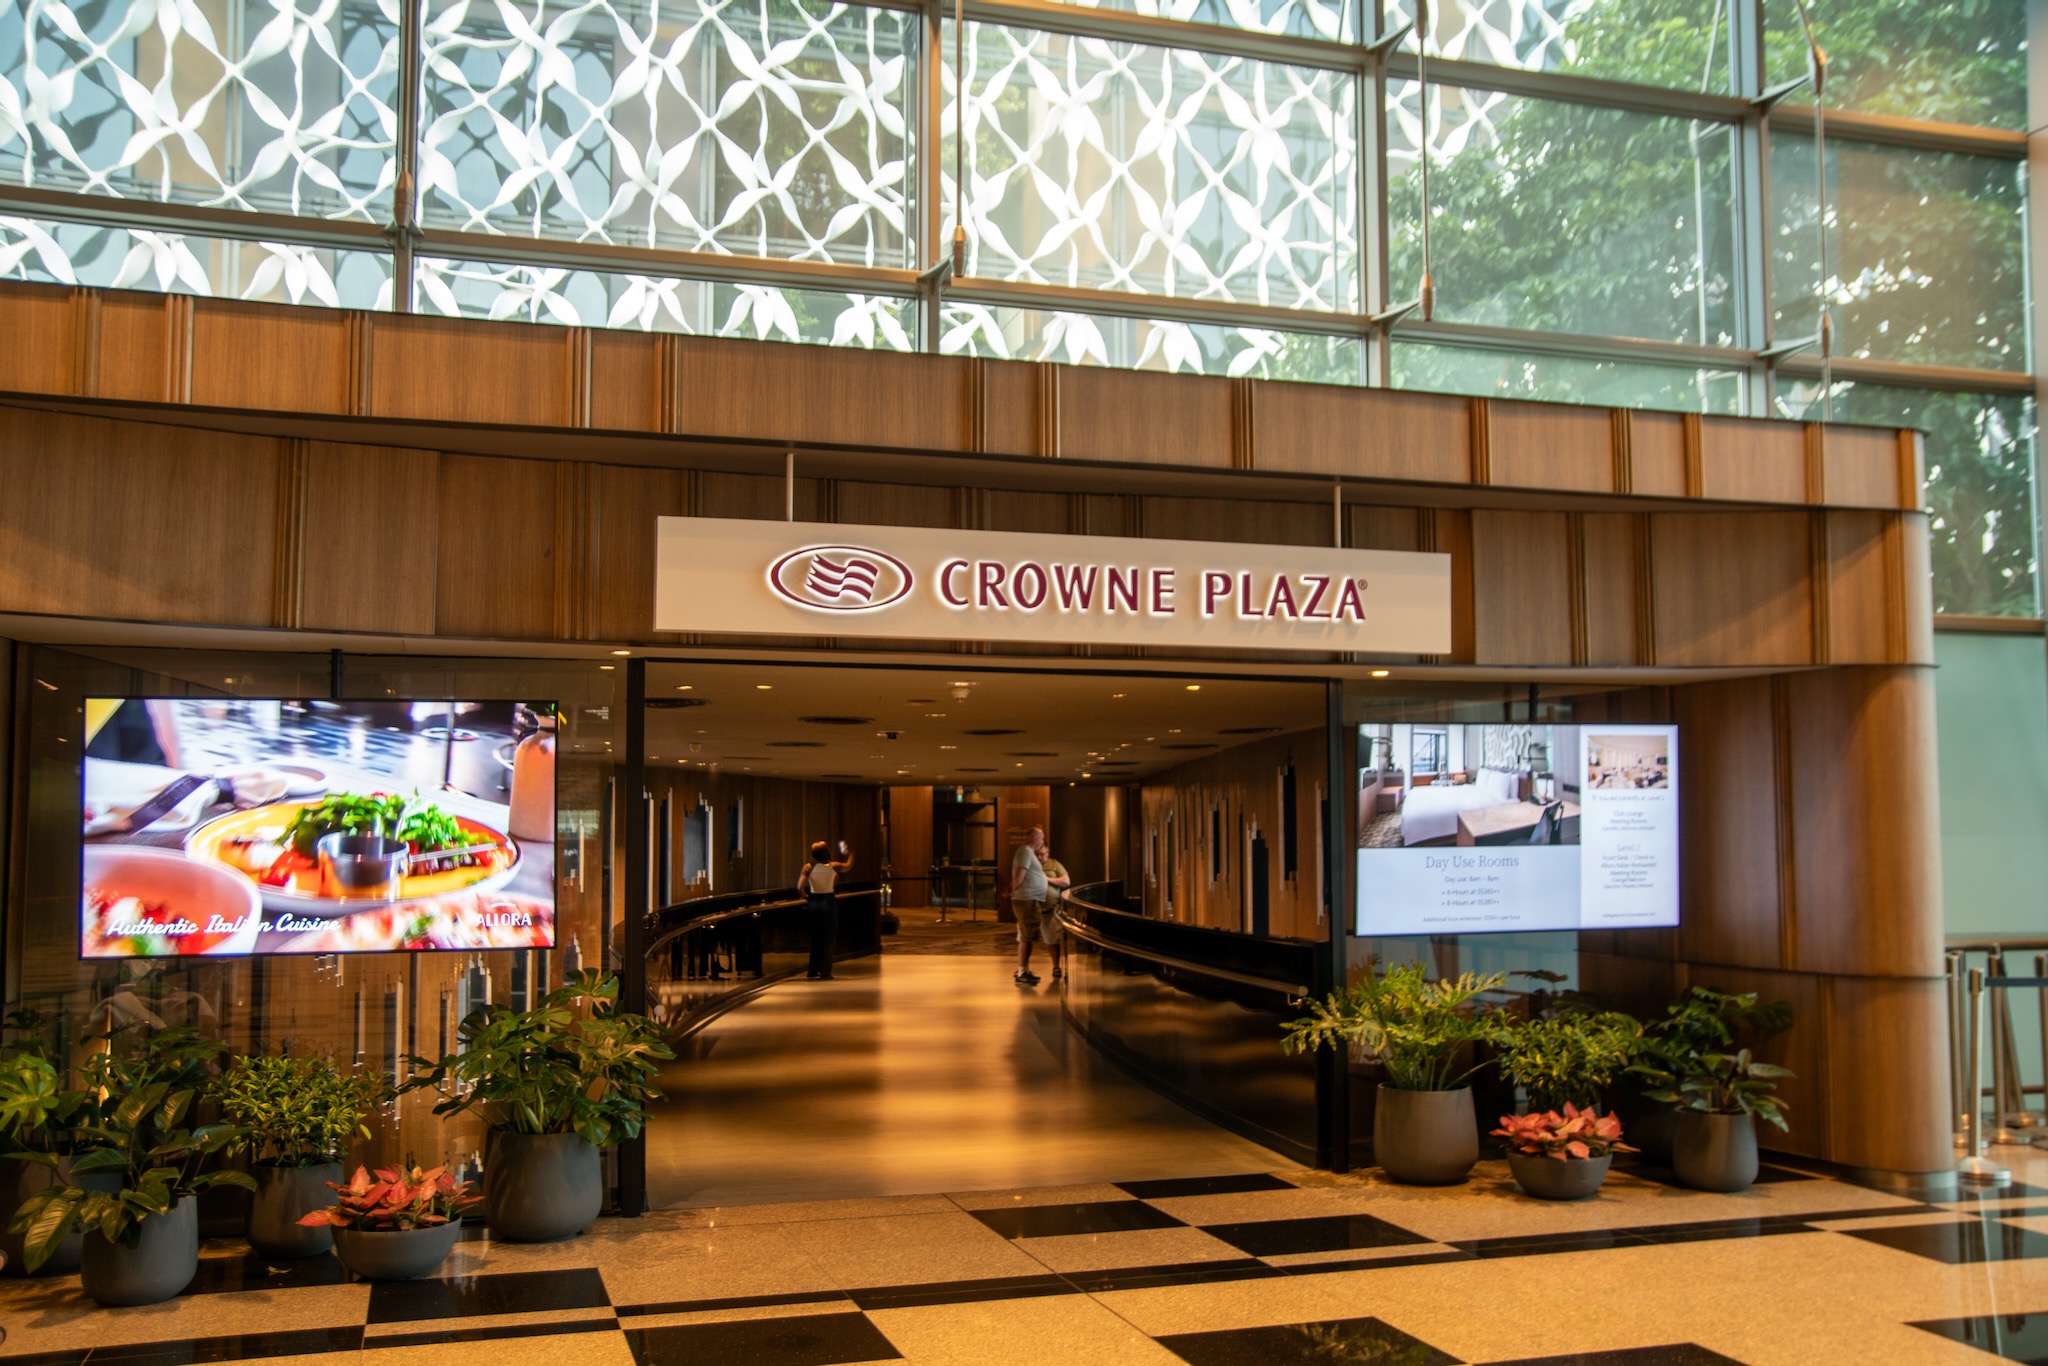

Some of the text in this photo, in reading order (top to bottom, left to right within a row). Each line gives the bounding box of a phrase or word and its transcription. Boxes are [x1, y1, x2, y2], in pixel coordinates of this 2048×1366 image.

[940, 559, 1176, 613] CROWNE
[1425, 854, 1520, 872] Day Use Rooms
[106, 911, 341, 937] Authentic Italin Cuisine
[475, 912, 533, 927] ALLORA
